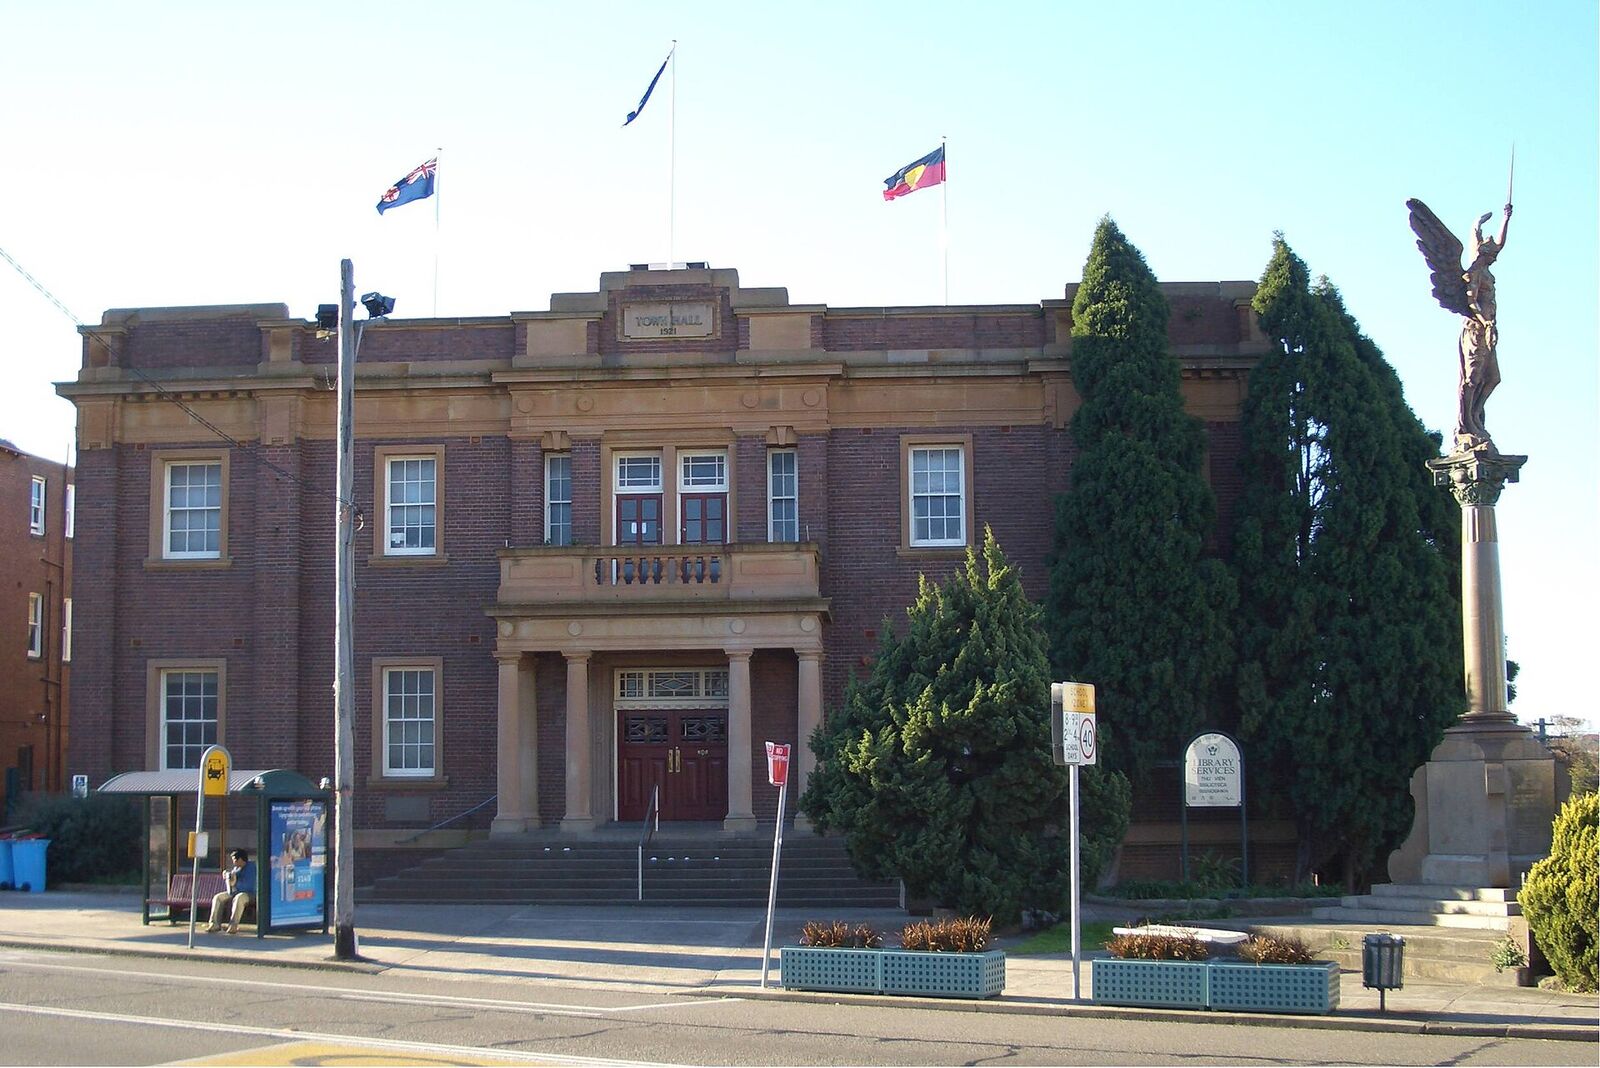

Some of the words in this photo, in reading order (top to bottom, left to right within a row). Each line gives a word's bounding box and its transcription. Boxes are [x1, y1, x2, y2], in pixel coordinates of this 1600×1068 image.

[635, 316, 667, 327] TOWN
[671, 315, 703, 326] HALL
[1070, 687, 1088, 697] SCHOOL
[1083, 730, 1093, 748] 40
[1193, 759, 1234, 767] LIBRARY
[1192, 767, 1236, 775] SERVICES
